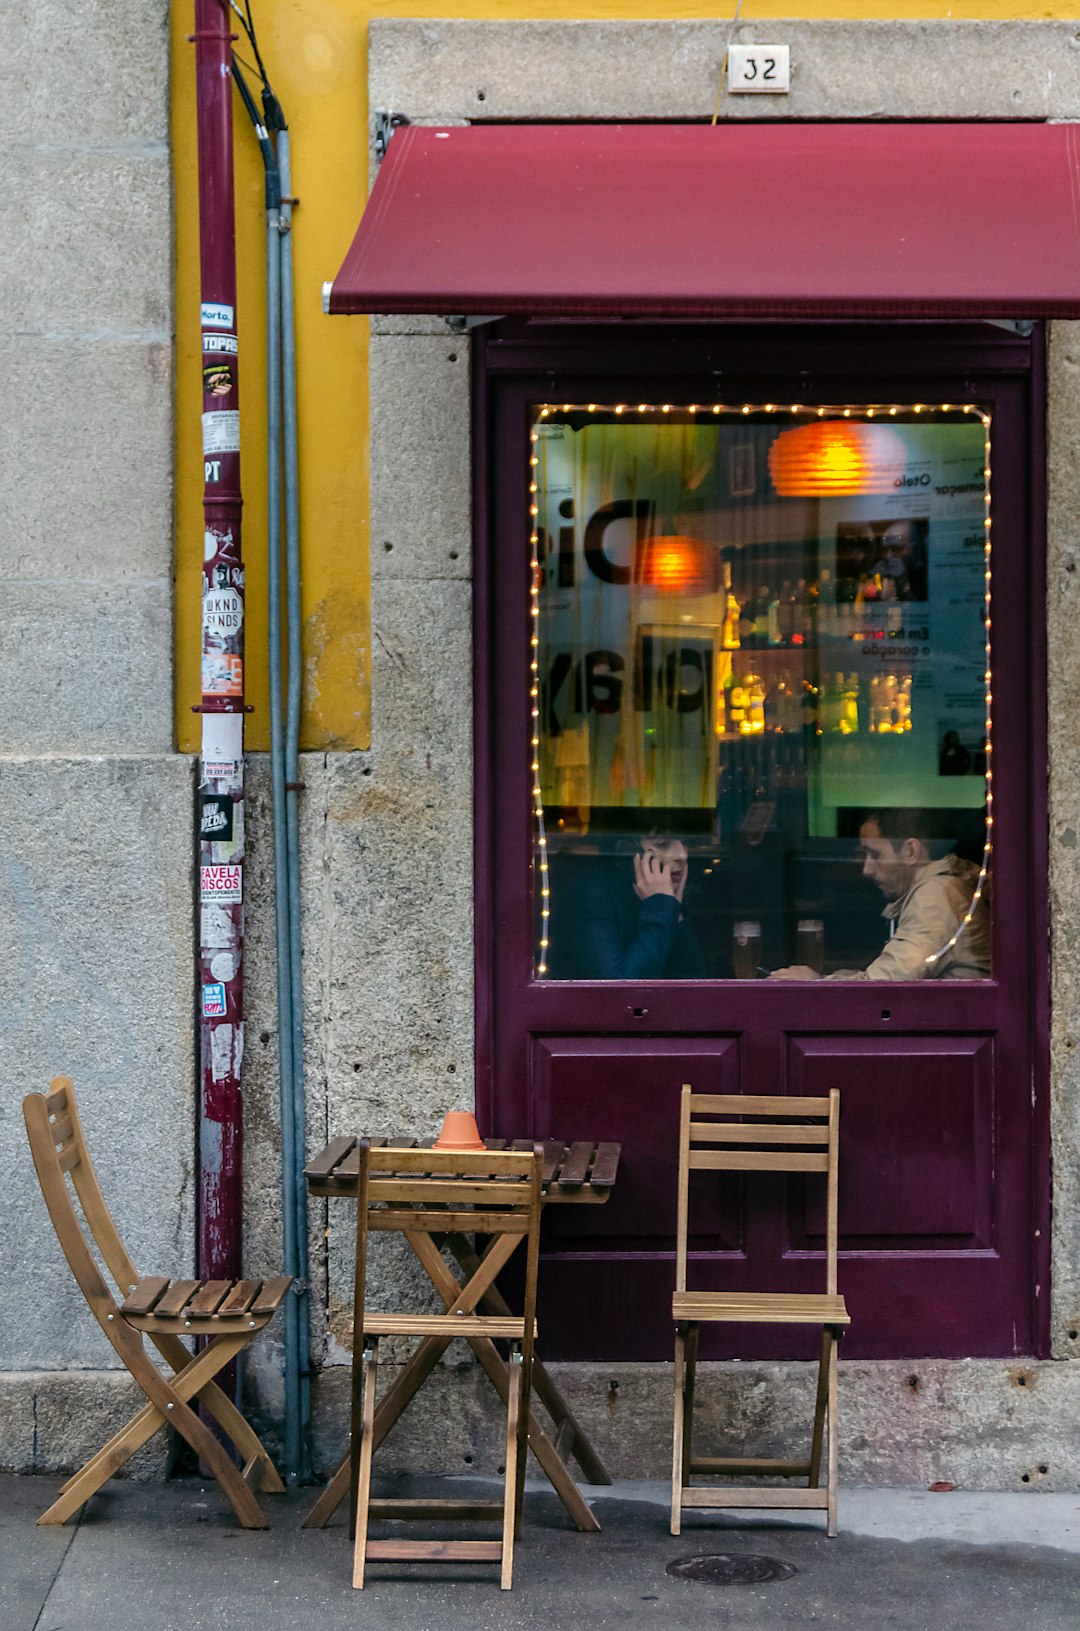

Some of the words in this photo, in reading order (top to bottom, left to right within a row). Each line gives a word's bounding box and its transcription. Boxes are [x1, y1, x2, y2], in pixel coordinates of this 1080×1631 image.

[206, 598, 239, 611] WKND
[201, 866, 240, 879] FAVELA
[201, 878, 239, 890] DISCOS
